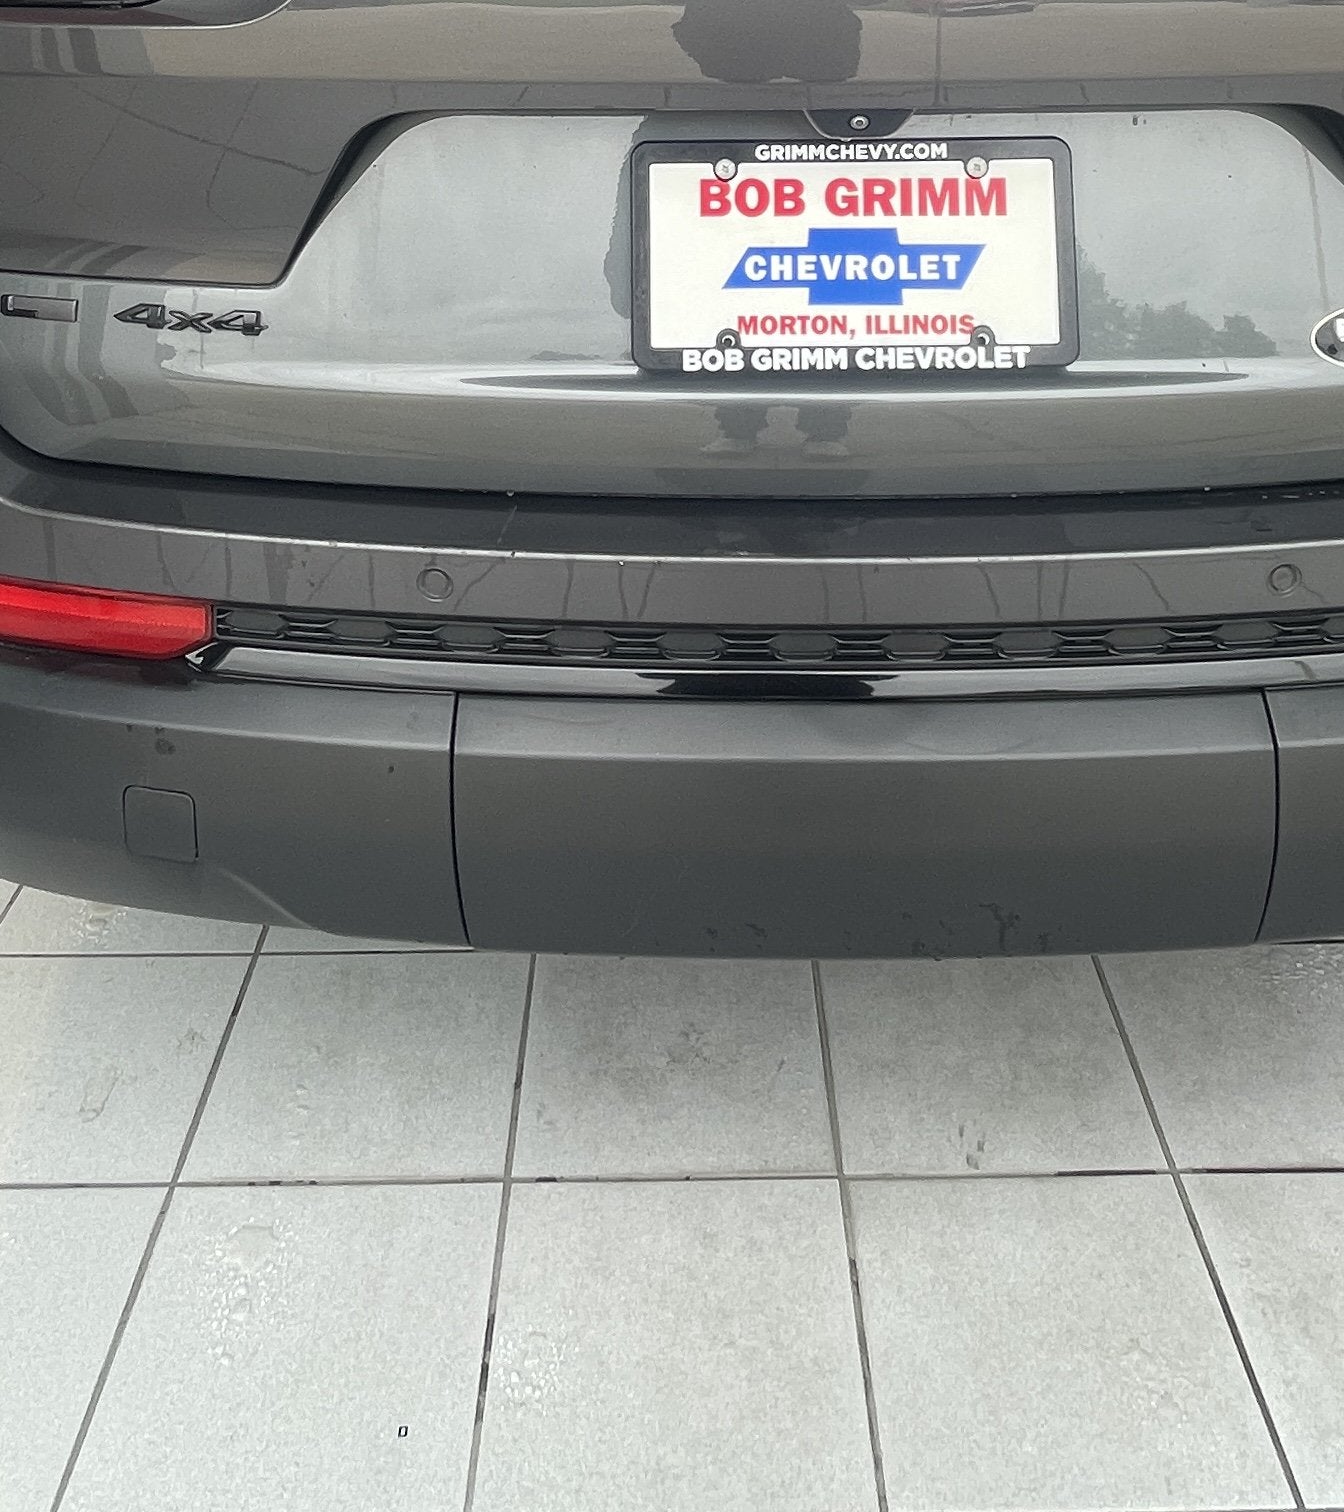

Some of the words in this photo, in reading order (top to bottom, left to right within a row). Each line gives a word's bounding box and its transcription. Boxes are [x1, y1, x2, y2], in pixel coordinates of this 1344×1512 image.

[754, 143, 947, 160] GRIMMCHEVY.COM
[699, 179, 805, 217] BOB
[824, 178, 1007, 216] GRIMM
[744, 254, 960, 280] CHEVROLET
[737, 315, 855, 339] MORTON,
[865, 315, 974, 335] ILLINOIS
[682, 348, 745, 371] BOB
[750, 348, 848, 371] GRIMM
[855, 346, 1030, 369] CHEVROLET
